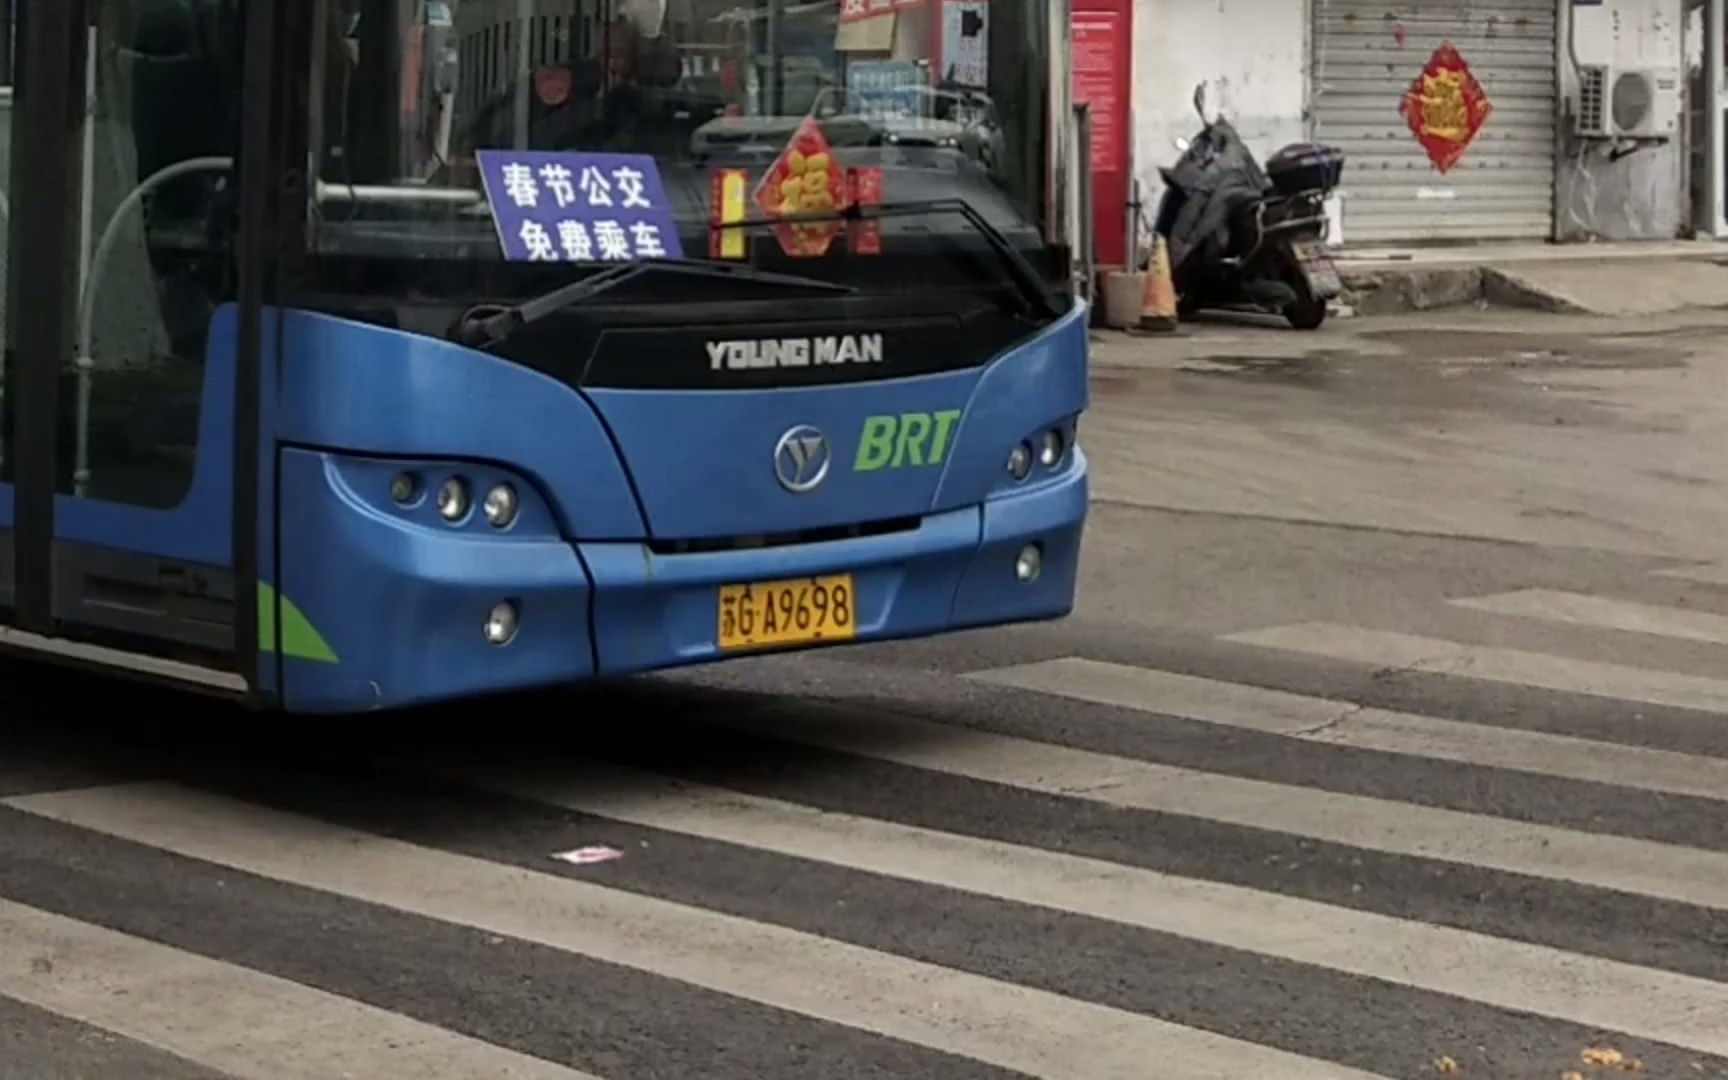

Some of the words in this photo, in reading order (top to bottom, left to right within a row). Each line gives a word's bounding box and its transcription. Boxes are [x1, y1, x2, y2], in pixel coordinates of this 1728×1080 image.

[501, 162, 652, 208] 春节公交
[519, 219, 667, 261] 免费乘车
[706, 338, 811, 369] YOUNG
[813, 333, 883, 365] MAN
[853, 409, 961, 472] BRT
